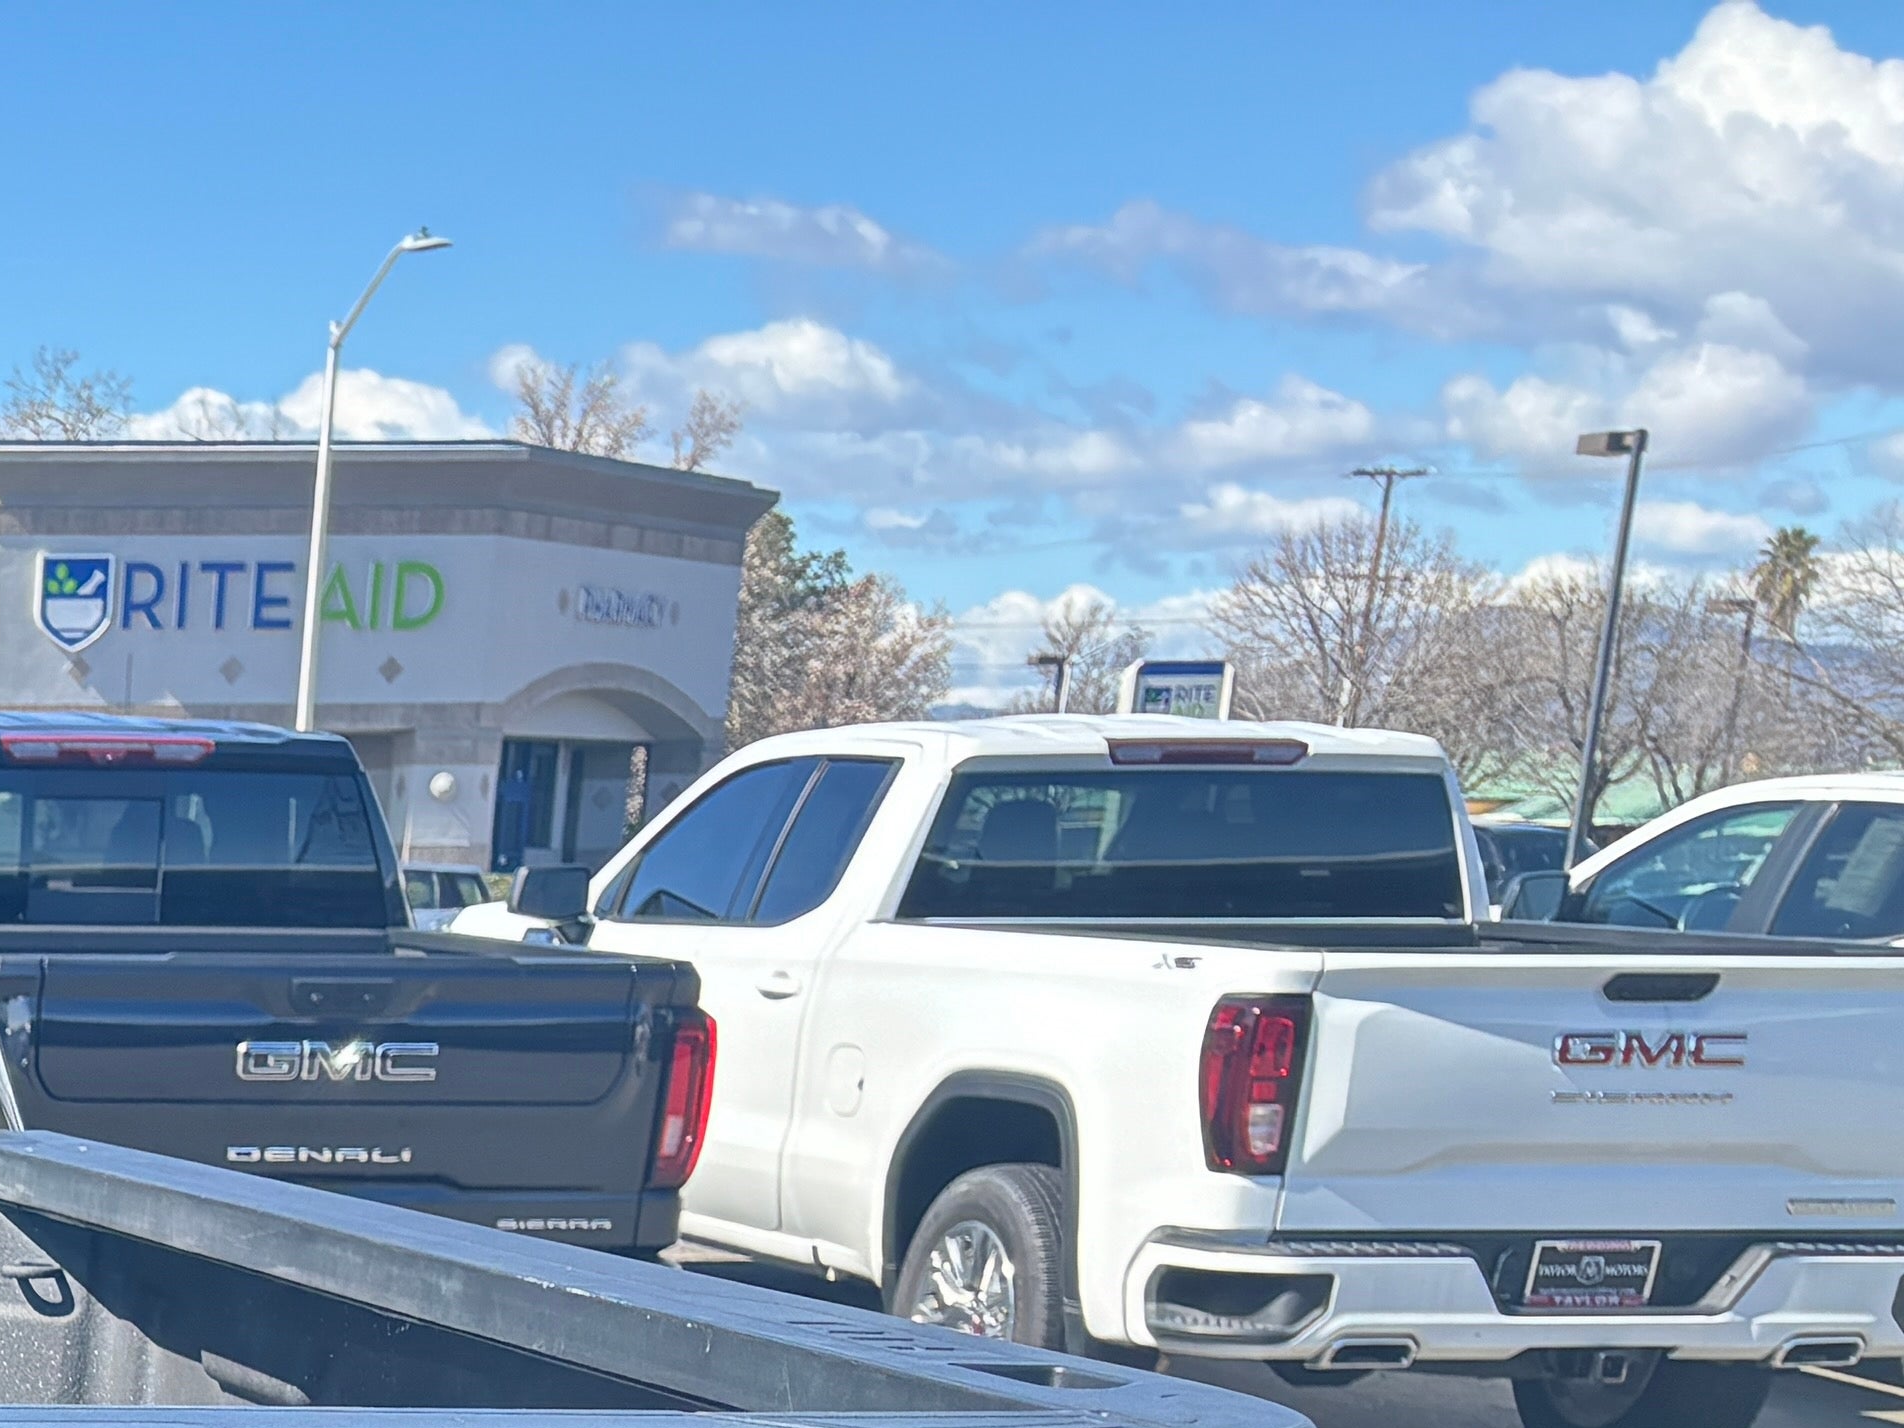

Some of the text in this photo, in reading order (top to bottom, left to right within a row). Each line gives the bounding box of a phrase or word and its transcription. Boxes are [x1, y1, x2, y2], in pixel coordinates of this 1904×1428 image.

[121, 561, 445, 631] RITE AID
[236, 1040, 440, 1082] GMC
[1552, 1031, 1748, 1068] GMC
[227, 1146, 412, 1163] DENALI
[497, 1218, 612, 1231] SIERRA
